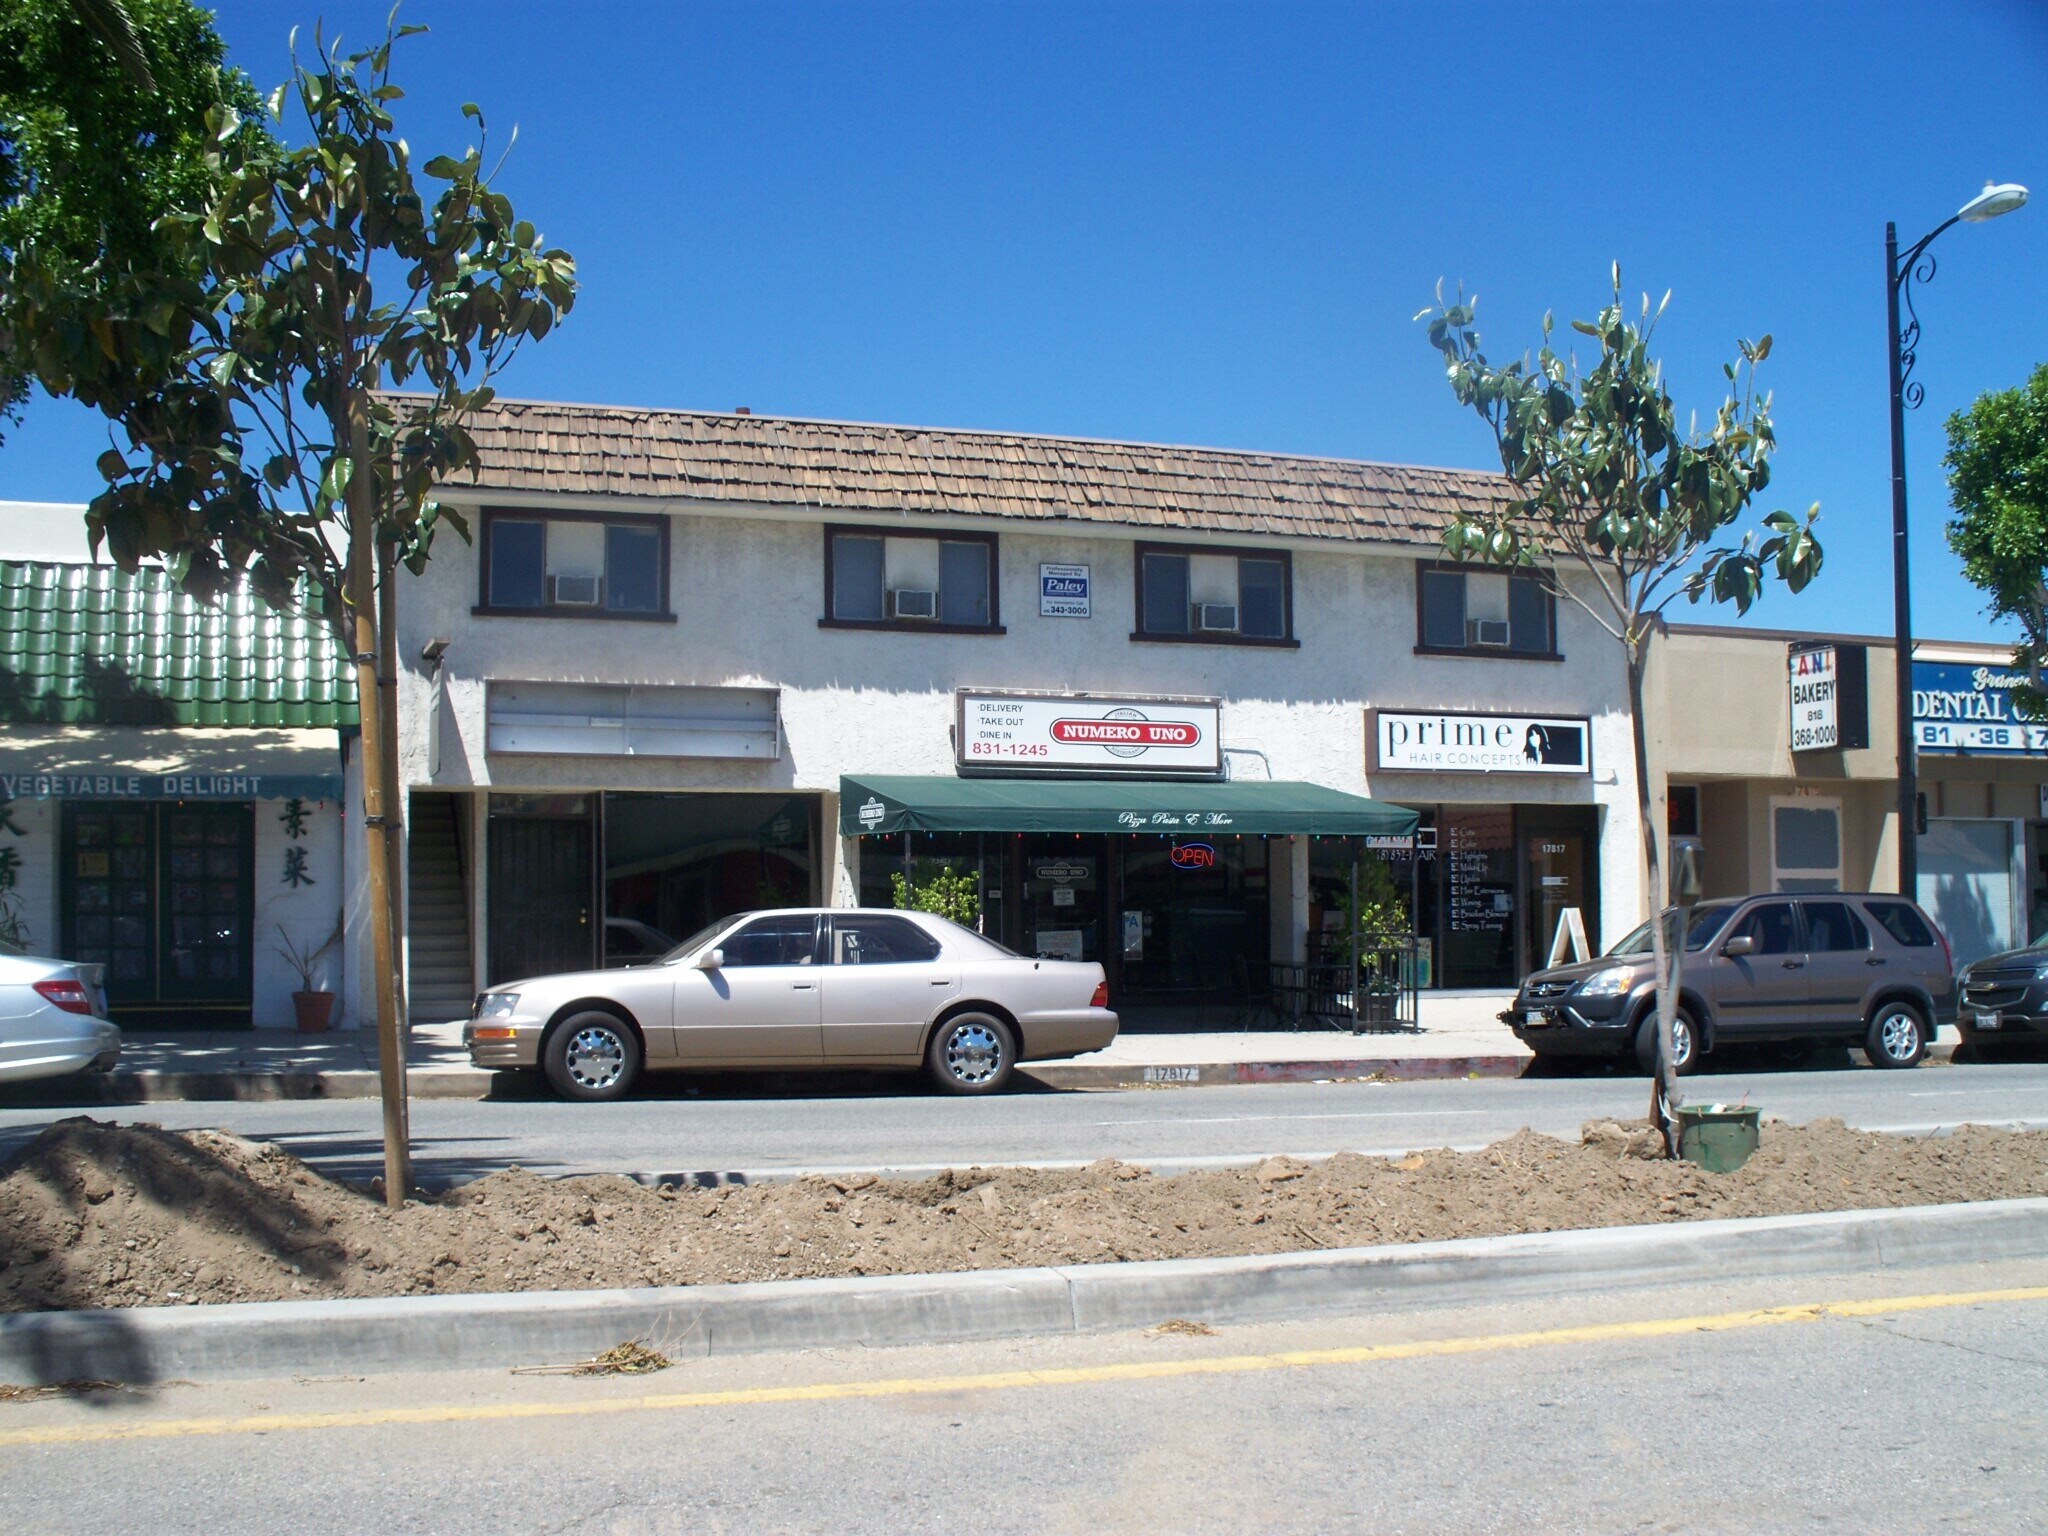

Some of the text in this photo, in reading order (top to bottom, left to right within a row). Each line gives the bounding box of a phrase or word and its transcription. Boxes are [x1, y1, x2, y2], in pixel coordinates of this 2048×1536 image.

[1046, 579, 1085, 593] Paley
[1051, 606, 1087, 614] 343-3000
[1798, 651, 1830, 676] ANI
[1794, 680, 1835, 705] BAKERY
[980, 704, 1023, 712] DELIVERY
[1912, 689, 2007, 722] DENTAL
[1114, 710, 1137, 718] ITALIAN
[1808, 709, 1823, 721] 818
[980, 717, 1003, 725] TAKE
[980, 730, 1001, 739] DINE
[1063, 724, 1187, 741] NUMERO UNO
[1386, 718, 1513, 757] prime
[1795, 724, 1836, 747] 368-1000
[972, 742, 1048, 756] 831-1245
[1409, 753, 1521, 765] HAIR CONCEPTS
[2, 775, 261, 794] VEGETABLE DELIGHT
[1118, 812, 1147, 828] Pizza
[1151, 812, 1180, 824] Pasta
[1204, 812, 1233, 825] More
[1460, 839, 1478, 849] Color
[1542, 844, 1566, 853] 17817
[1171, 847, 1214, 866] OPEN
[1460, 850, 1488, 861] Highlights
[1129, 916, 1138, 928] A
[1155, 1067, 1191, 1080] 17817
